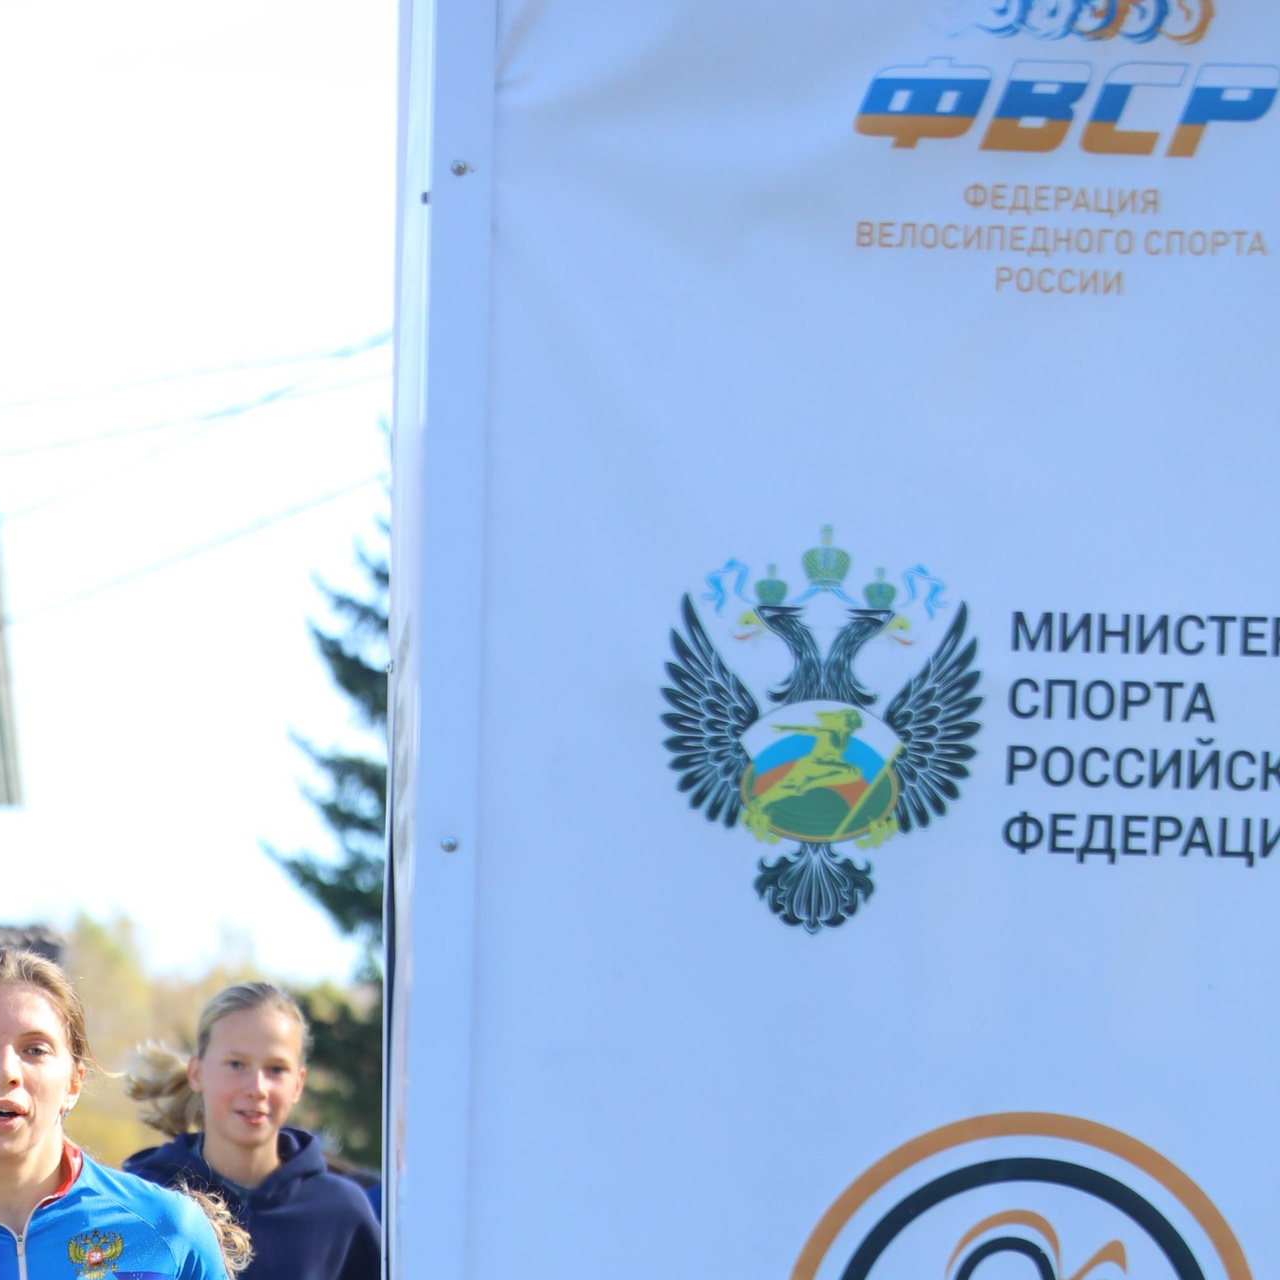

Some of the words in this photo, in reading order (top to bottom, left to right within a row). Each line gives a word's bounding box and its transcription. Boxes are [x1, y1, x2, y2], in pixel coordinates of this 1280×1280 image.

[853, 56, 1280, 158] ФВСР
[963, 182, 1161, 218] ФЕДЕРАЦИЯ
[855, 222, 1135, 257] ВЕЛОСИПЕДНОГО
[1144, 230, 1268, 257] СПОРТА
[994, 266, 1125, 296] РОССИИ
[1011, 610, 1280, 658] МИНИСТЕ
[1007, 677, 1216, 723] СПОРТА
